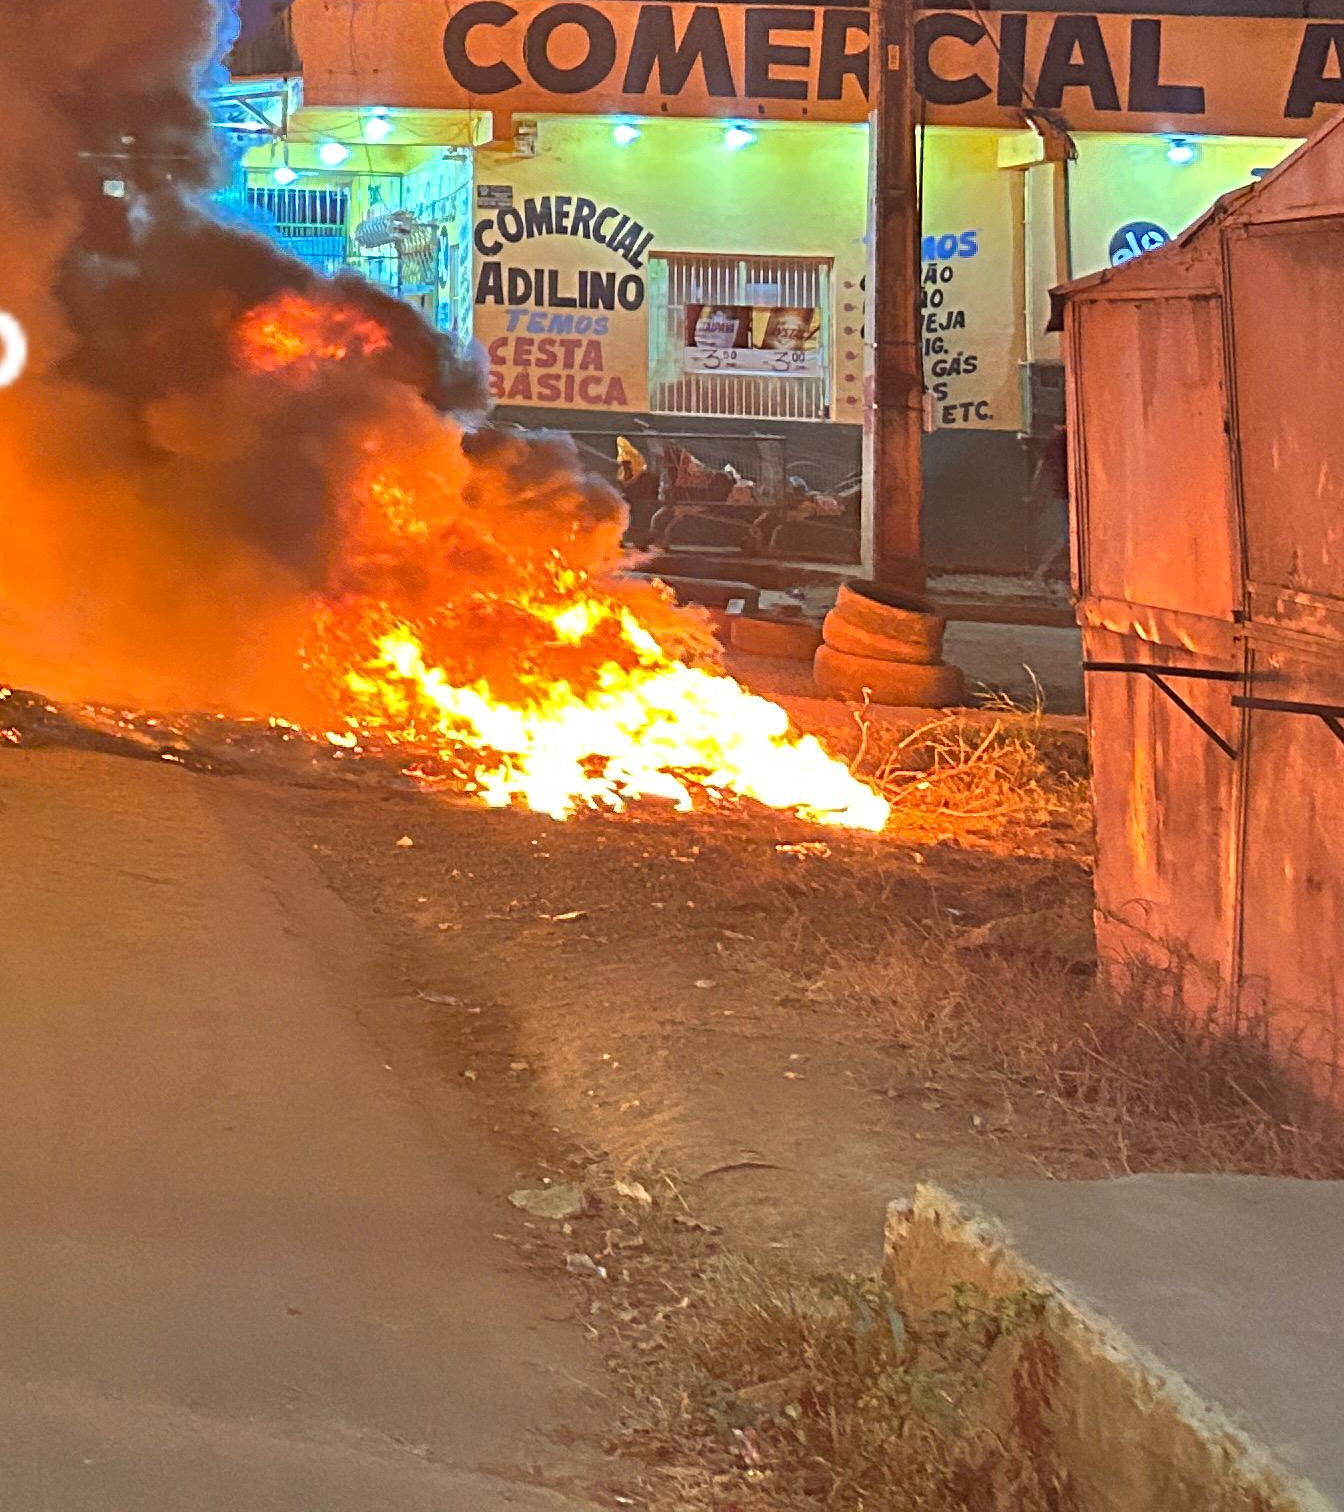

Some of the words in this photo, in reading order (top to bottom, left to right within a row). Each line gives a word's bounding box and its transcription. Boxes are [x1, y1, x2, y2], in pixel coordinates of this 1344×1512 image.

[442, 1, 1205, 114] COMERCIAL
[474, 195, 655, 270] COMERCIAL
[474, 261, 645, 311] ADILINO
[505, 308, 609, 336] TEMOS
[488, 336, 604, 372] CESTA
[931, 351, 978, 378] GÁS
[941, 399, 994, 425] ETC.
